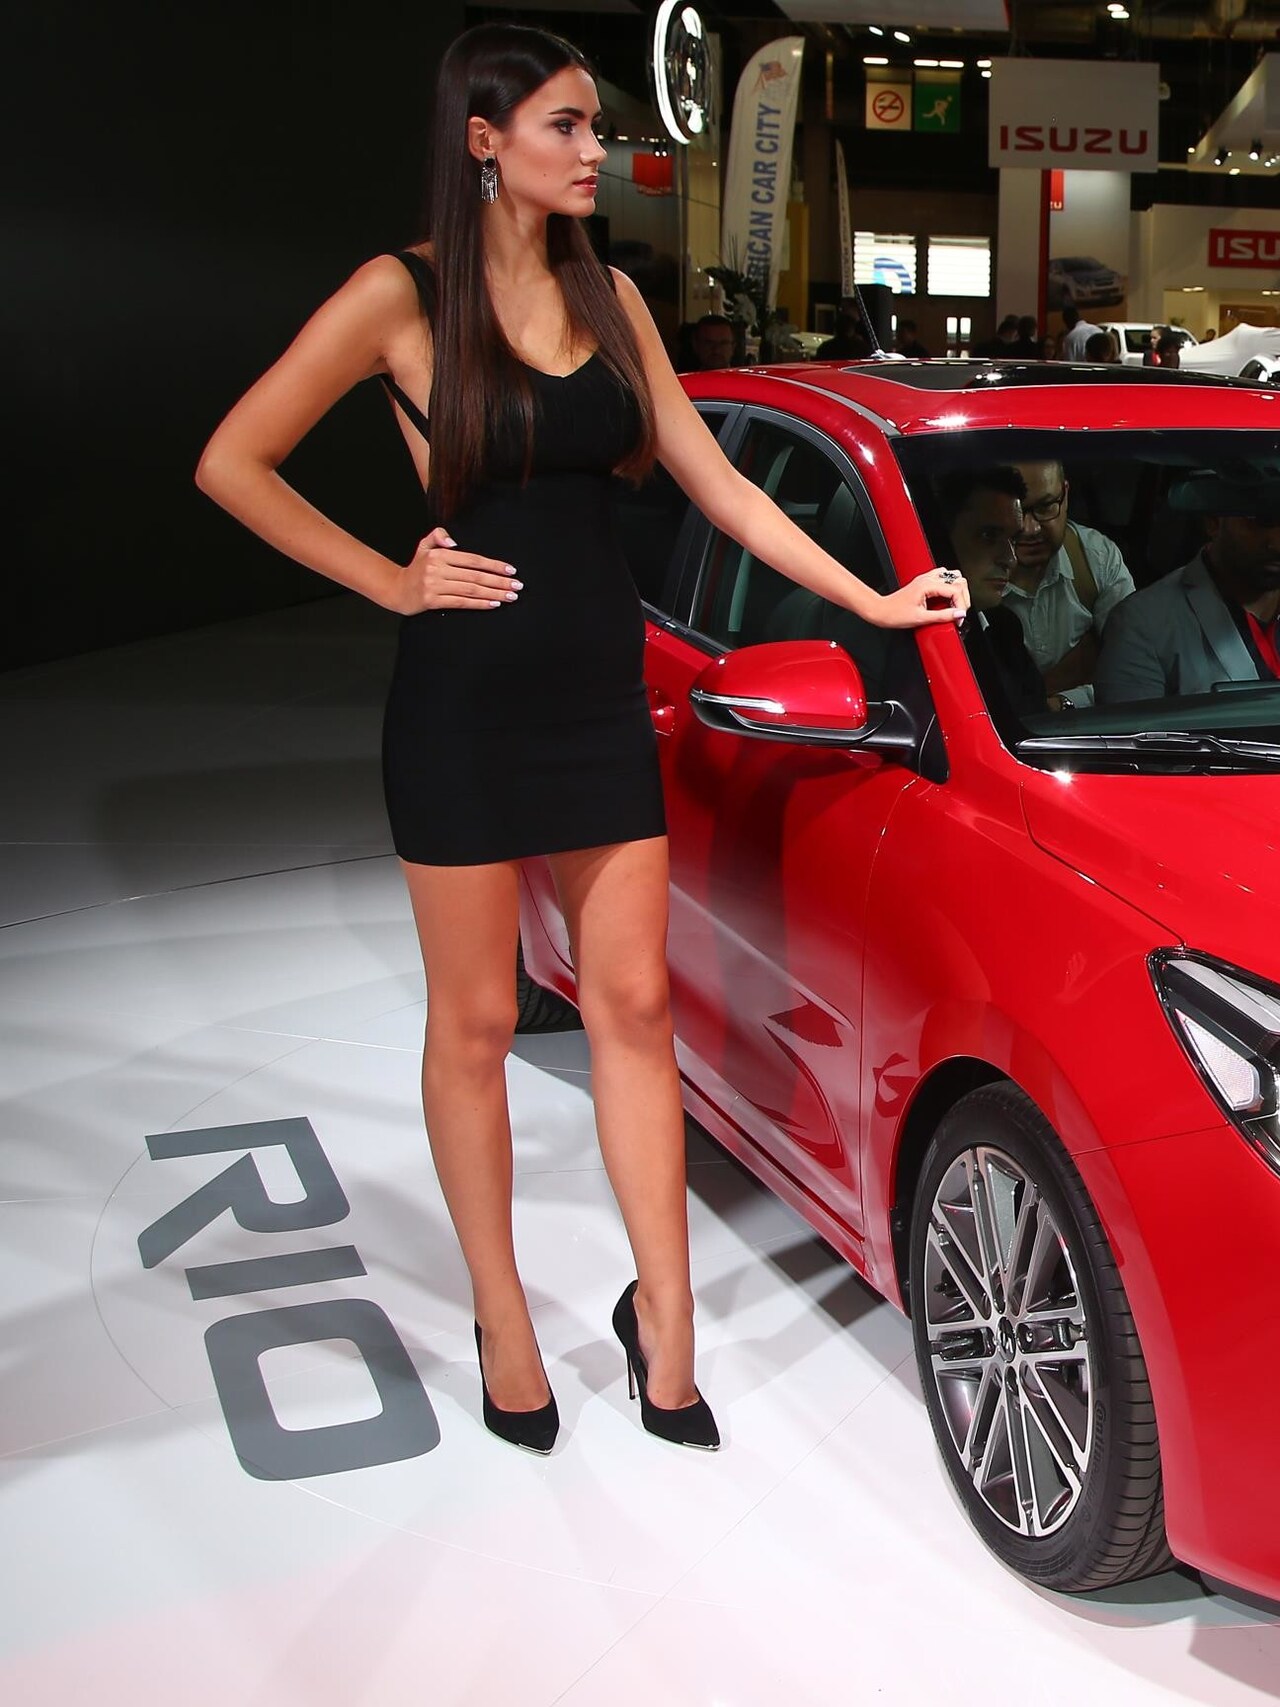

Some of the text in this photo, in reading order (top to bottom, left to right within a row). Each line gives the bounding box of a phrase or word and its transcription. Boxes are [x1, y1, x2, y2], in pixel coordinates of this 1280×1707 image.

[747, 103, 781, 292] RICAN CAR CITY
[1000, 125, 1148, 154] ISUZU
[137, 1116, 441, 1481] RIO
